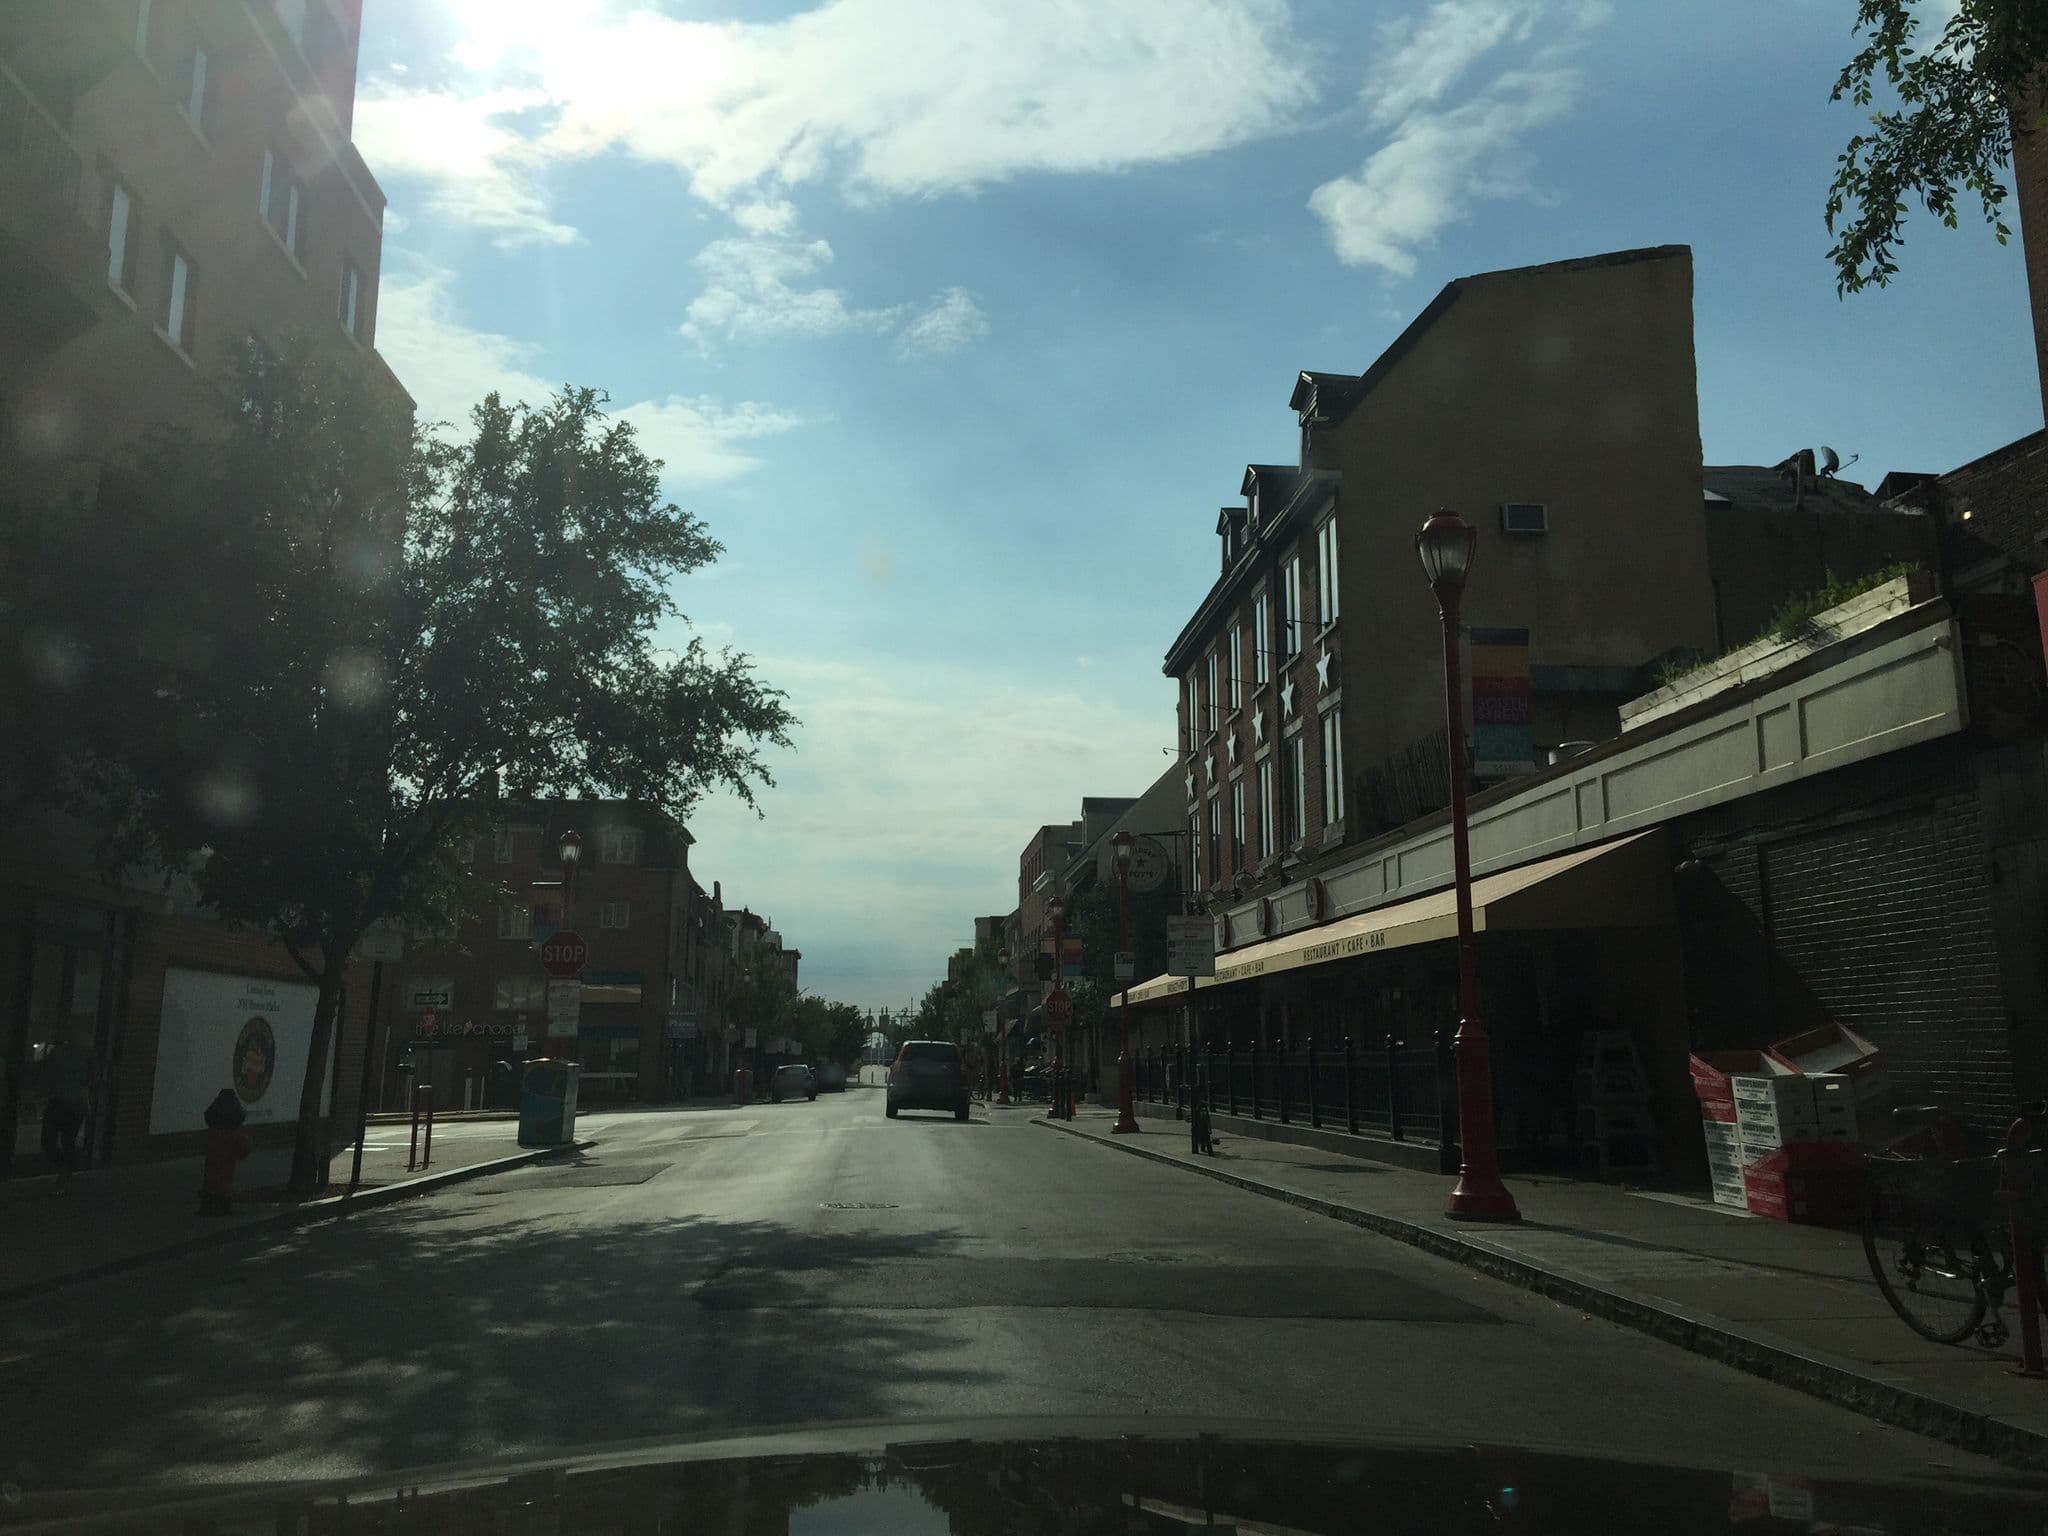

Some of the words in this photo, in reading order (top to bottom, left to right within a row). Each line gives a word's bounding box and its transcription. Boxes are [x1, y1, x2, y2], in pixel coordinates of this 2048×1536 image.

[543, 944, 584, 962] STOP
[1303, 942, 1340, 962] RESTAURANT
[1347, 937, 1363, 953] CAFE
[1370, 932, 1386, 948] BAR
[1048, 1000, 1071, 1013] STOP
